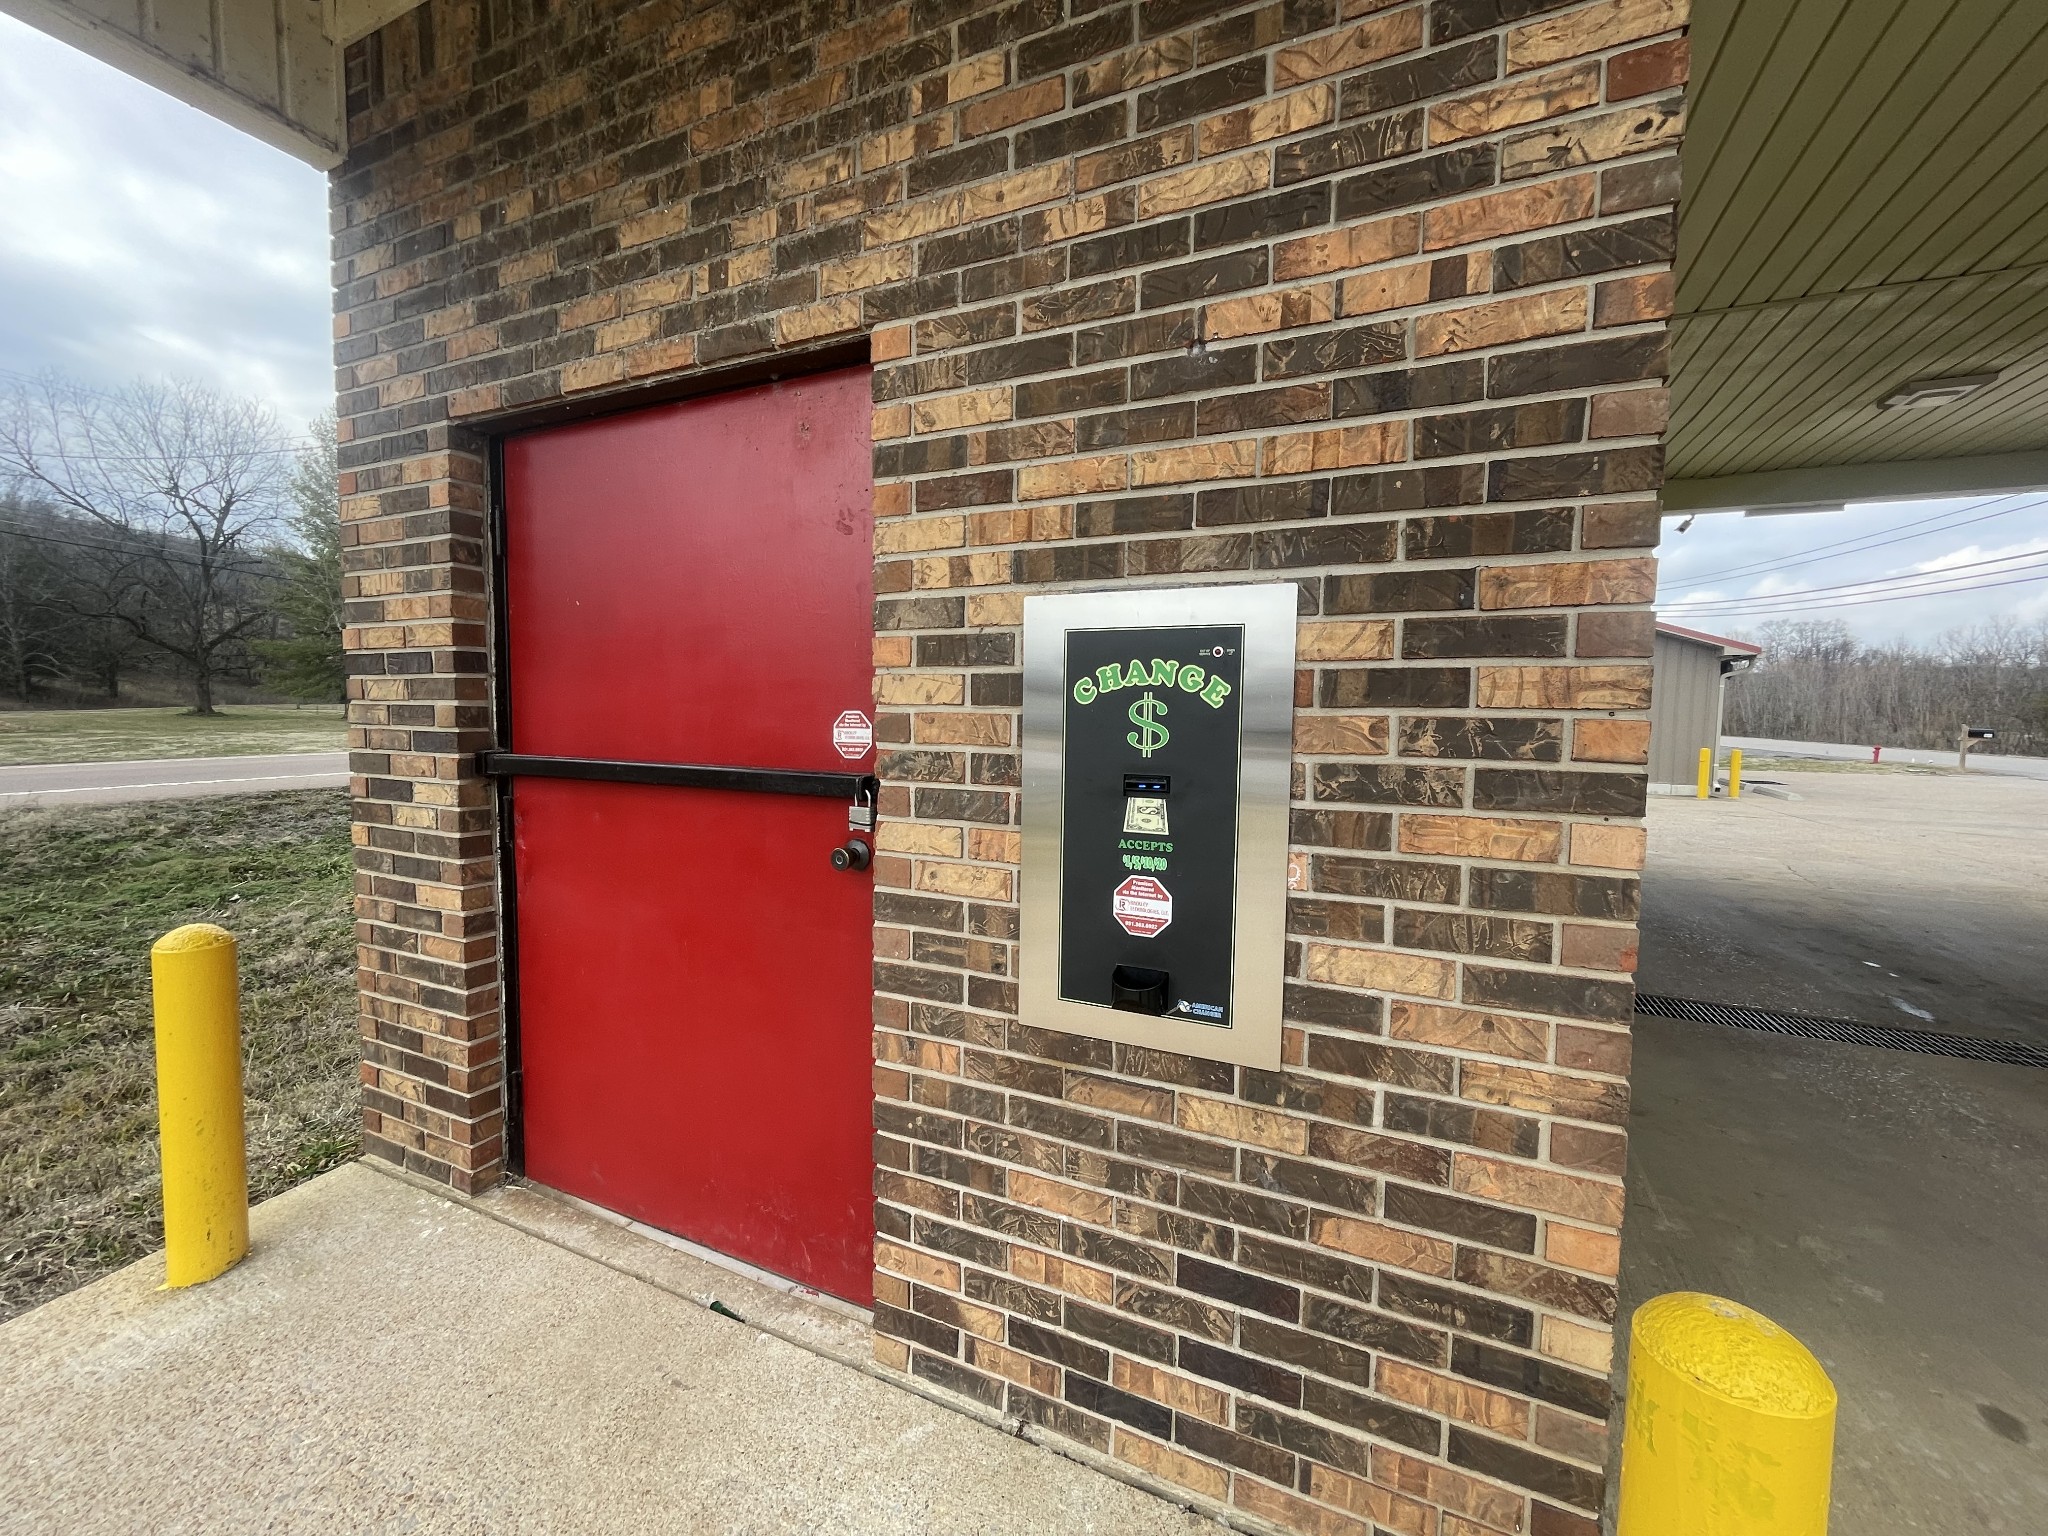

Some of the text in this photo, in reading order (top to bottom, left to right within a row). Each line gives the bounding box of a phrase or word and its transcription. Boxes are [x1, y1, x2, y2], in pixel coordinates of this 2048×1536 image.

[1073, 658, 1232, 709] CHANGE
[1127, 692, 1170, 758] $
[1118, 838, 1173, 852] ACCEPTS
